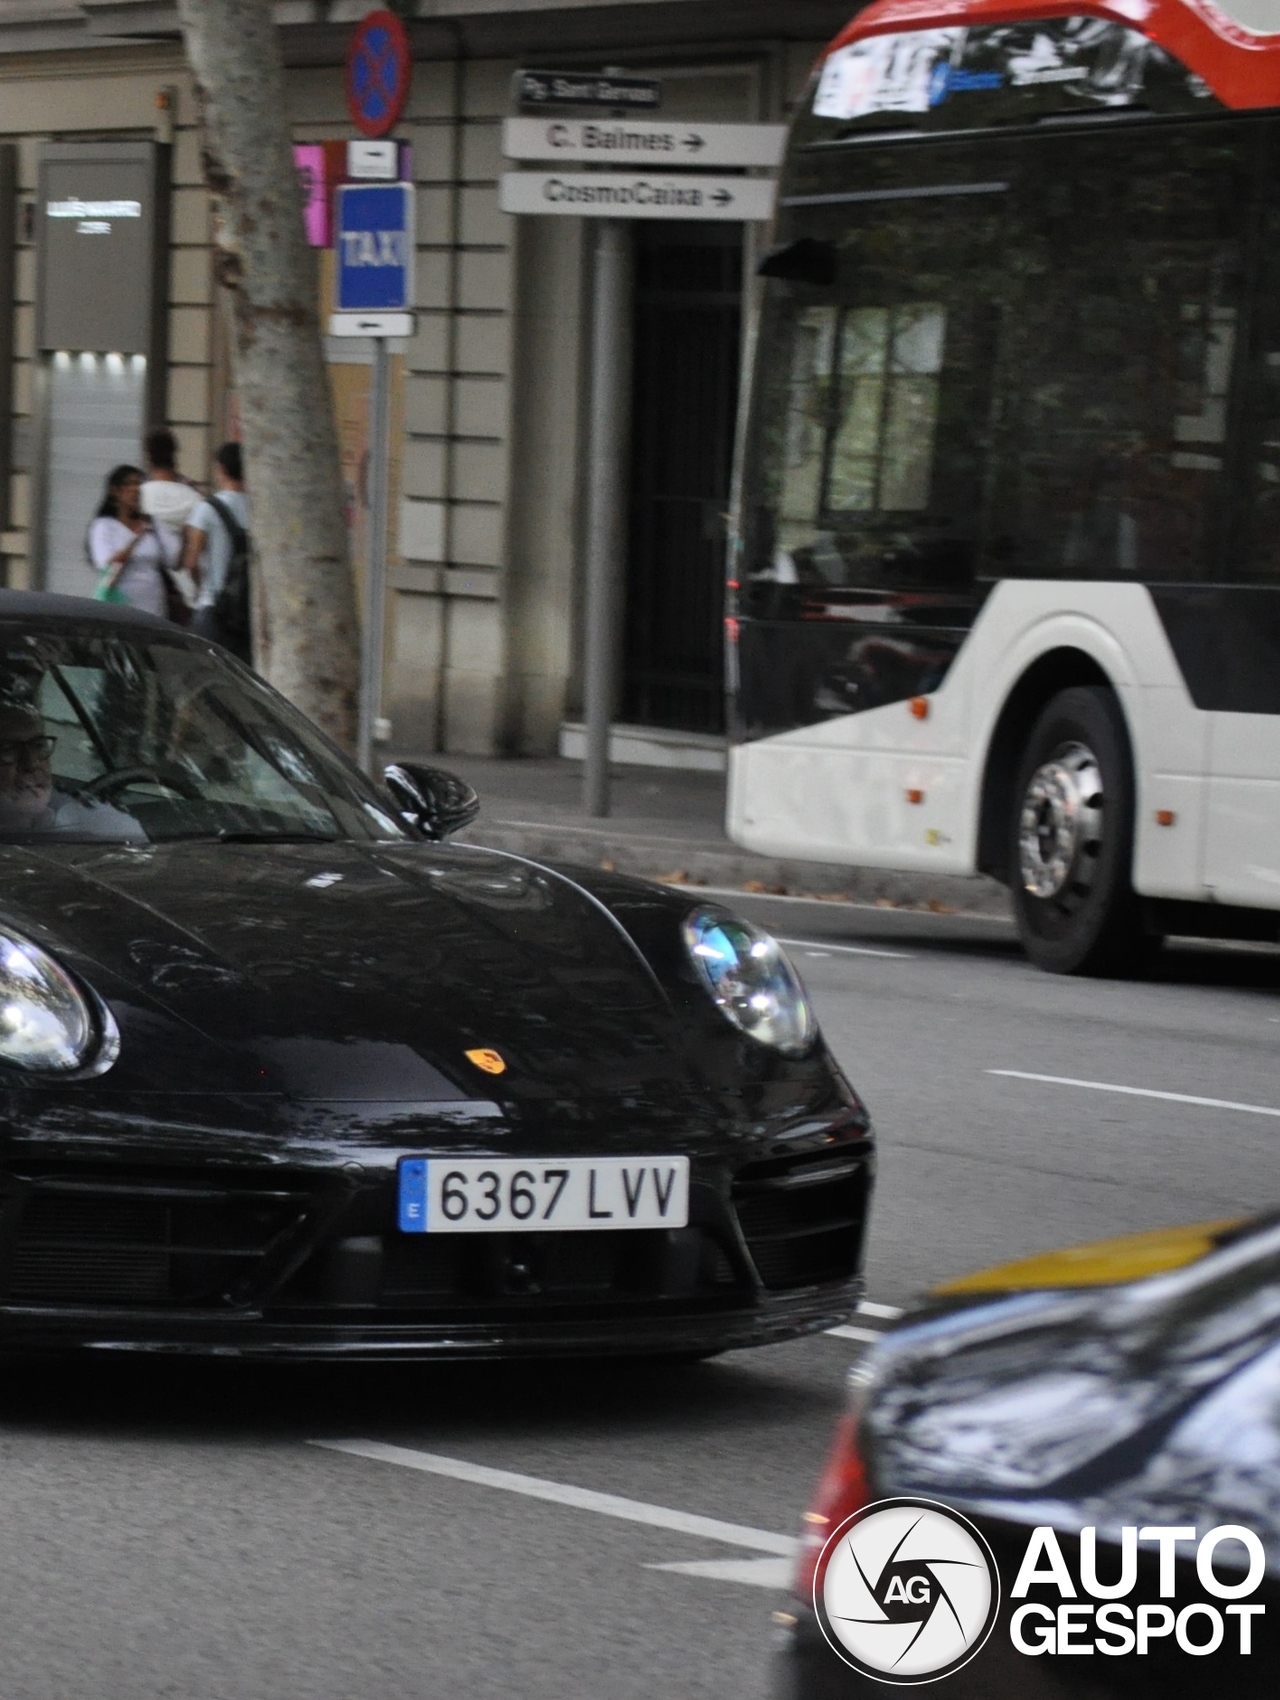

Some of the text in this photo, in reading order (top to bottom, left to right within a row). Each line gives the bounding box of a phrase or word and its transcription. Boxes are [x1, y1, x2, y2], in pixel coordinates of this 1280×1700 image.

[546, 124, 675, 151] C. Balmes
[543, 178, 704, 207] CosmoCaixa
[341, 230, 409, 268] TAXI
[441, 1168, 677, 1221] 6367 LVV
[408, 1203, 420, 1218] E
